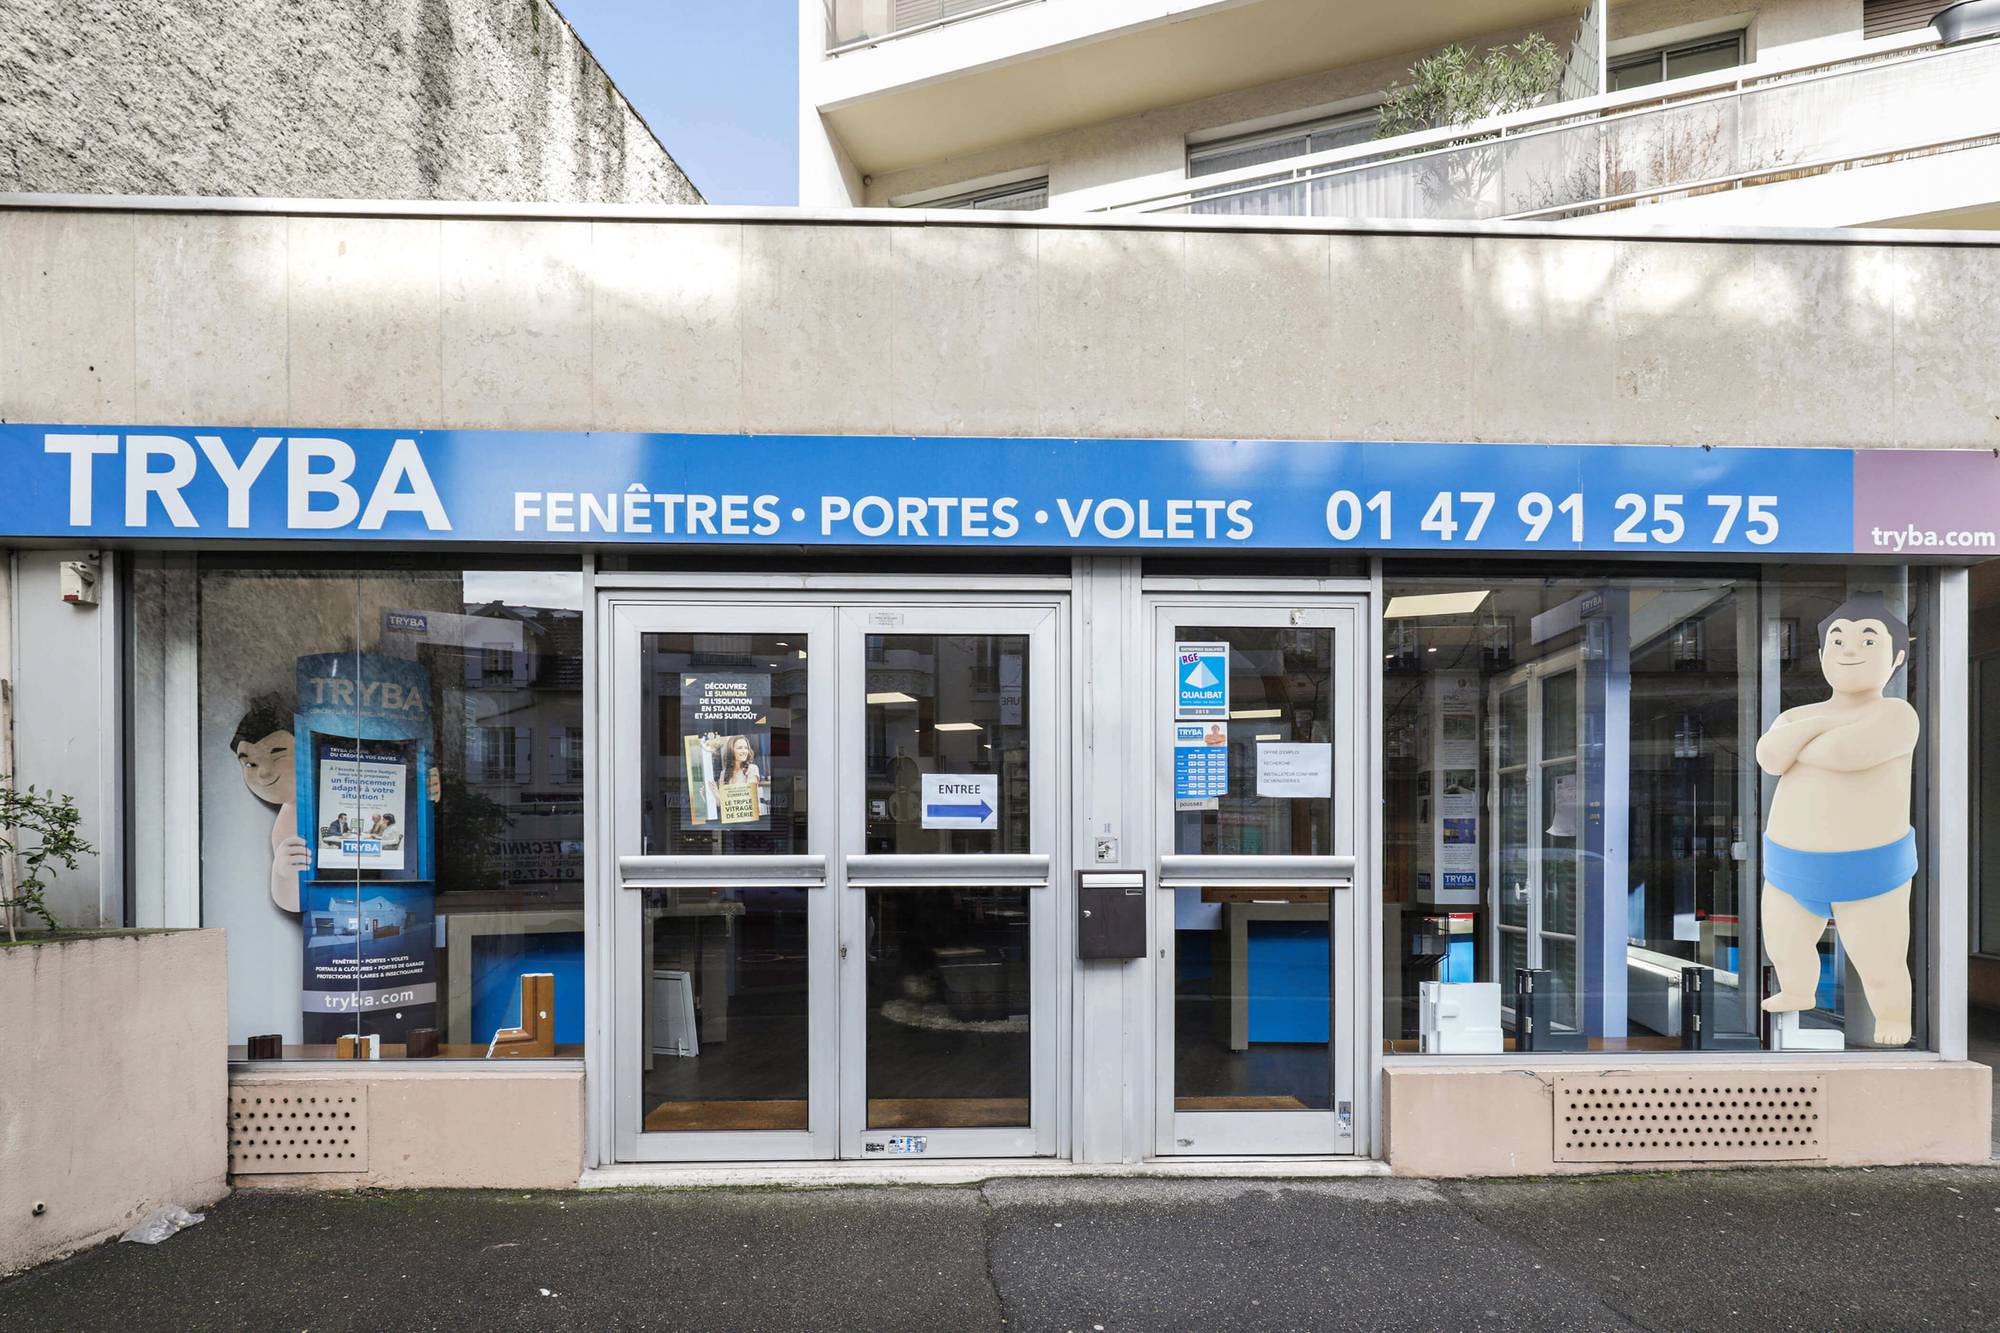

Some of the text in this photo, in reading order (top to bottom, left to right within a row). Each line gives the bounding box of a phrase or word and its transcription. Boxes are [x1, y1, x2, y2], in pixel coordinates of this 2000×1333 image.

[44, 433, 453, 530] TRYBA
[514, 482, 1254, 540] FENÊTRES PORTES VOLETS
[1326, 489, 1780, 545] 01 47 91 25 75
[1871, 523, 1996, 552] tryba.com
[389, 615, 425, 627] TRYBA
[1182, 652, 1199, 664] RGE
[704, 682, 747, 690] DÉCOUVREZ
[310, 678, 425, 712] TRYBA
[1181, 691, 1223, 699] QUALIBAT
[724, 711, 758, 720] SURCOÛT
[938, 784, 981, 795] ENTREE
[344, 843, 379, 852] TRYBA
[1445, 875, 1474, 883] TRYBA
[324, 990, 414, 1011] tryba.com
